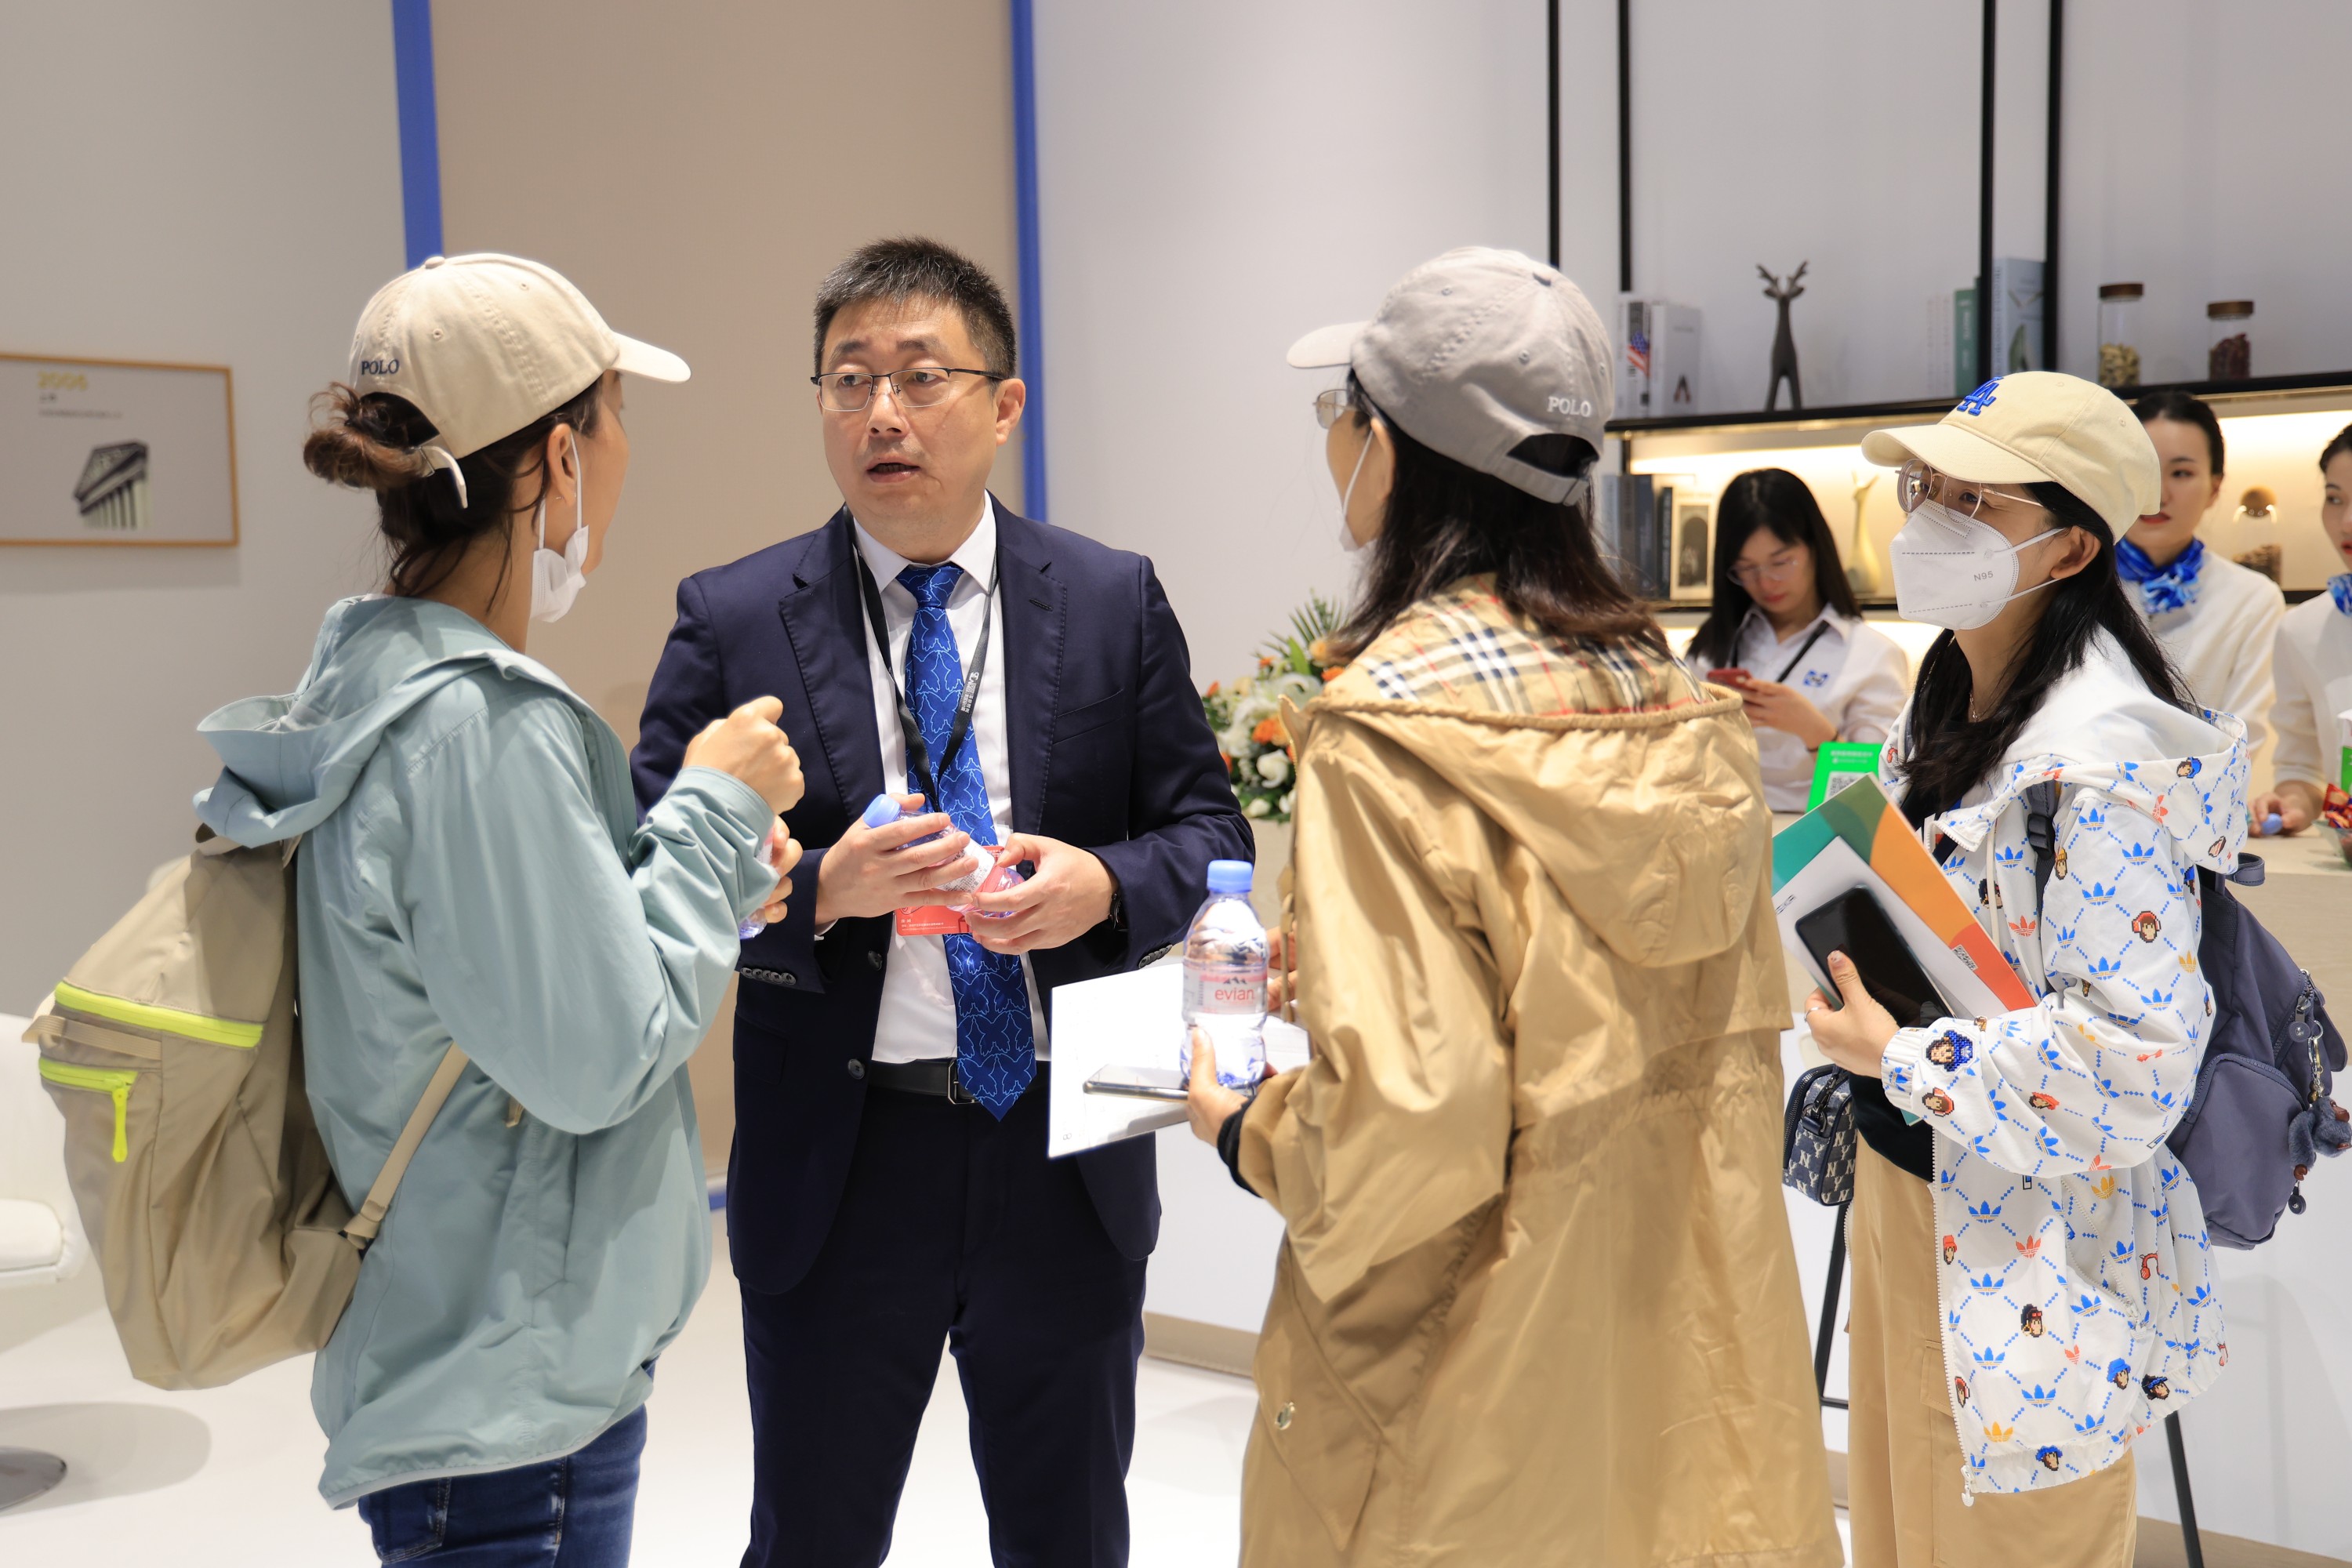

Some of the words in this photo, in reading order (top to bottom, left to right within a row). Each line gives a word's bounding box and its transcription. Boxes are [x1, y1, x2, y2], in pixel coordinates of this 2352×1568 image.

[361, 359, 400, 376] POLO
[1956, 376, 2005, 417] LA
[1547, 396, 1592, 418] POLO
[1973, 570, 1994, 582] N95
[1214, 987, 1255, 1001] evian
